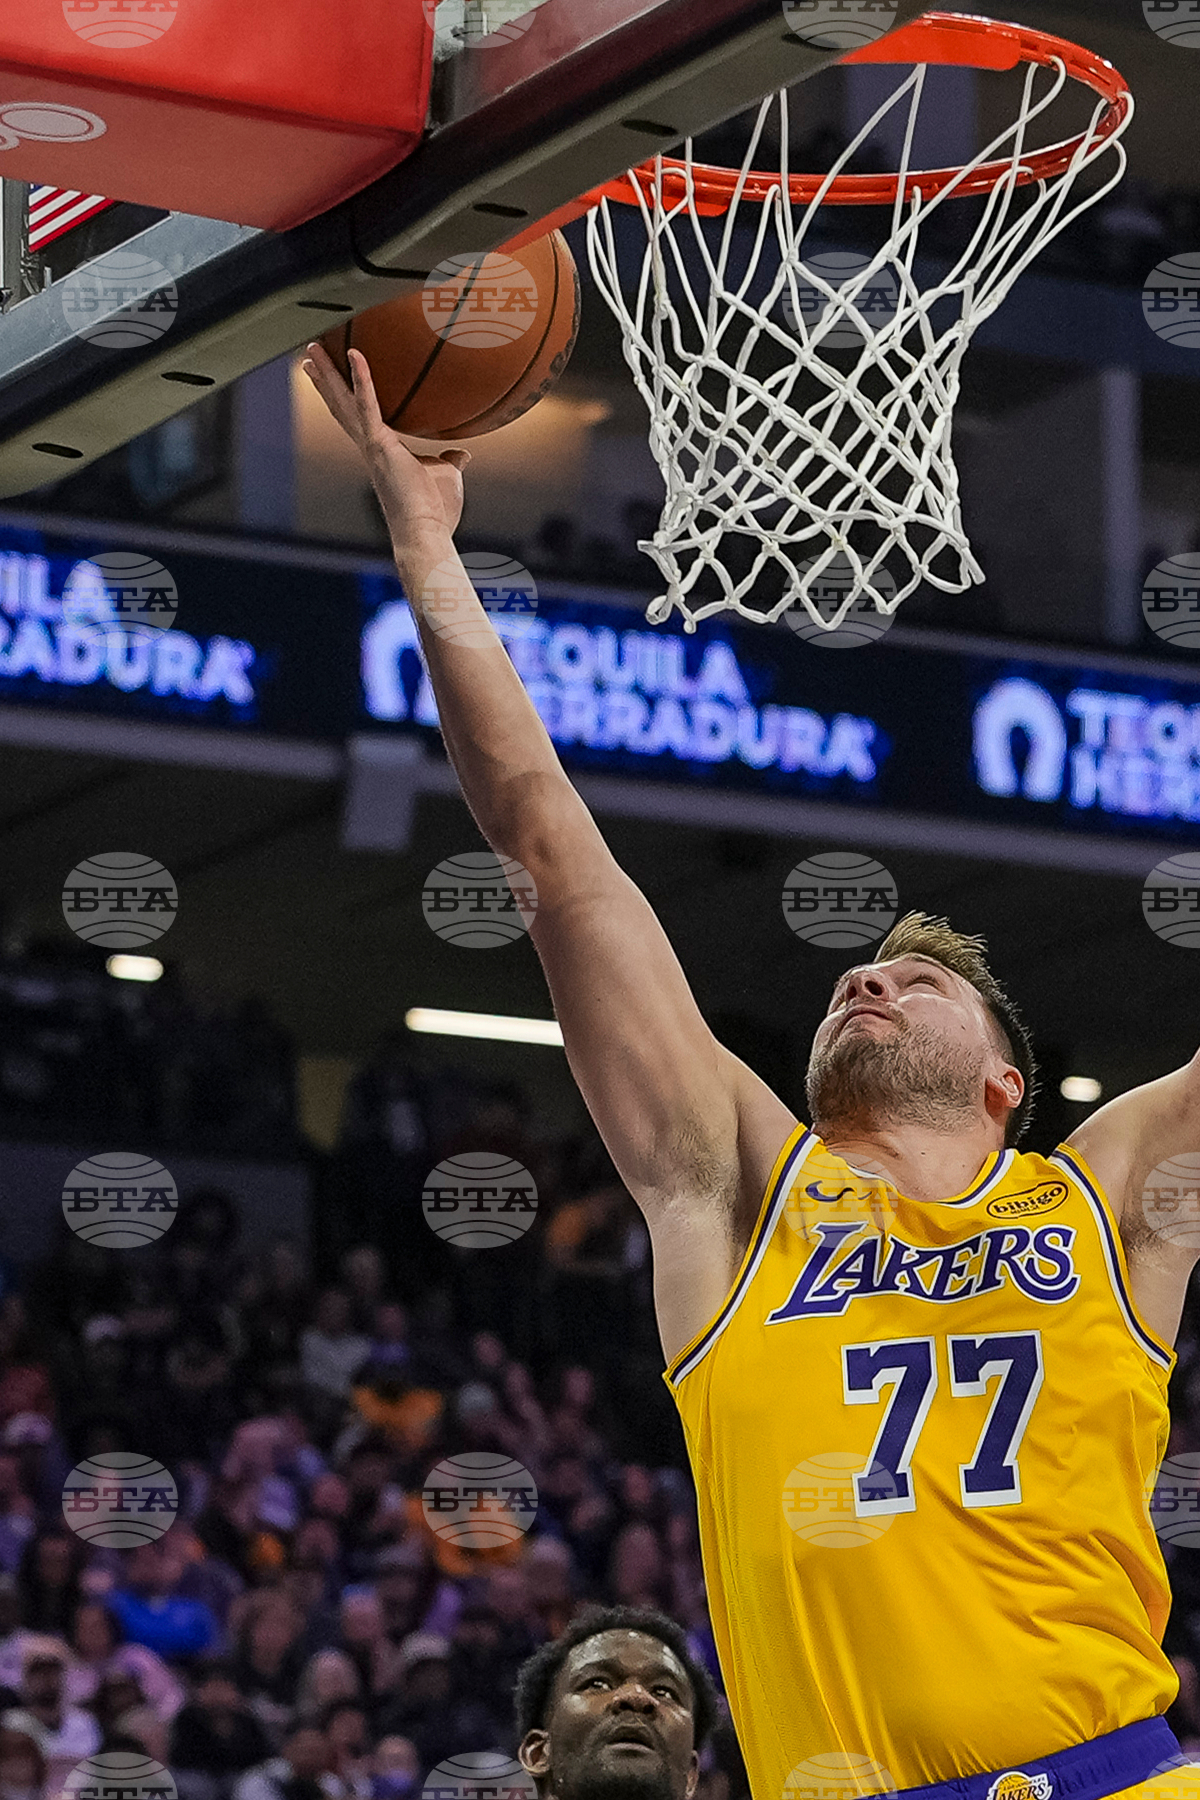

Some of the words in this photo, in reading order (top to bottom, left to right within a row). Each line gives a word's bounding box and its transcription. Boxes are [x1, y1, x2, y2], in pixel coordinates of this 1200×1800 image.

[491, 612, 752, 702] EQUILA
[993, 1187, 1062, 1213] bibigo
[764, 1221, 1082, 1326] LAKERS
[840, 1329, 1045, 1518] 77
